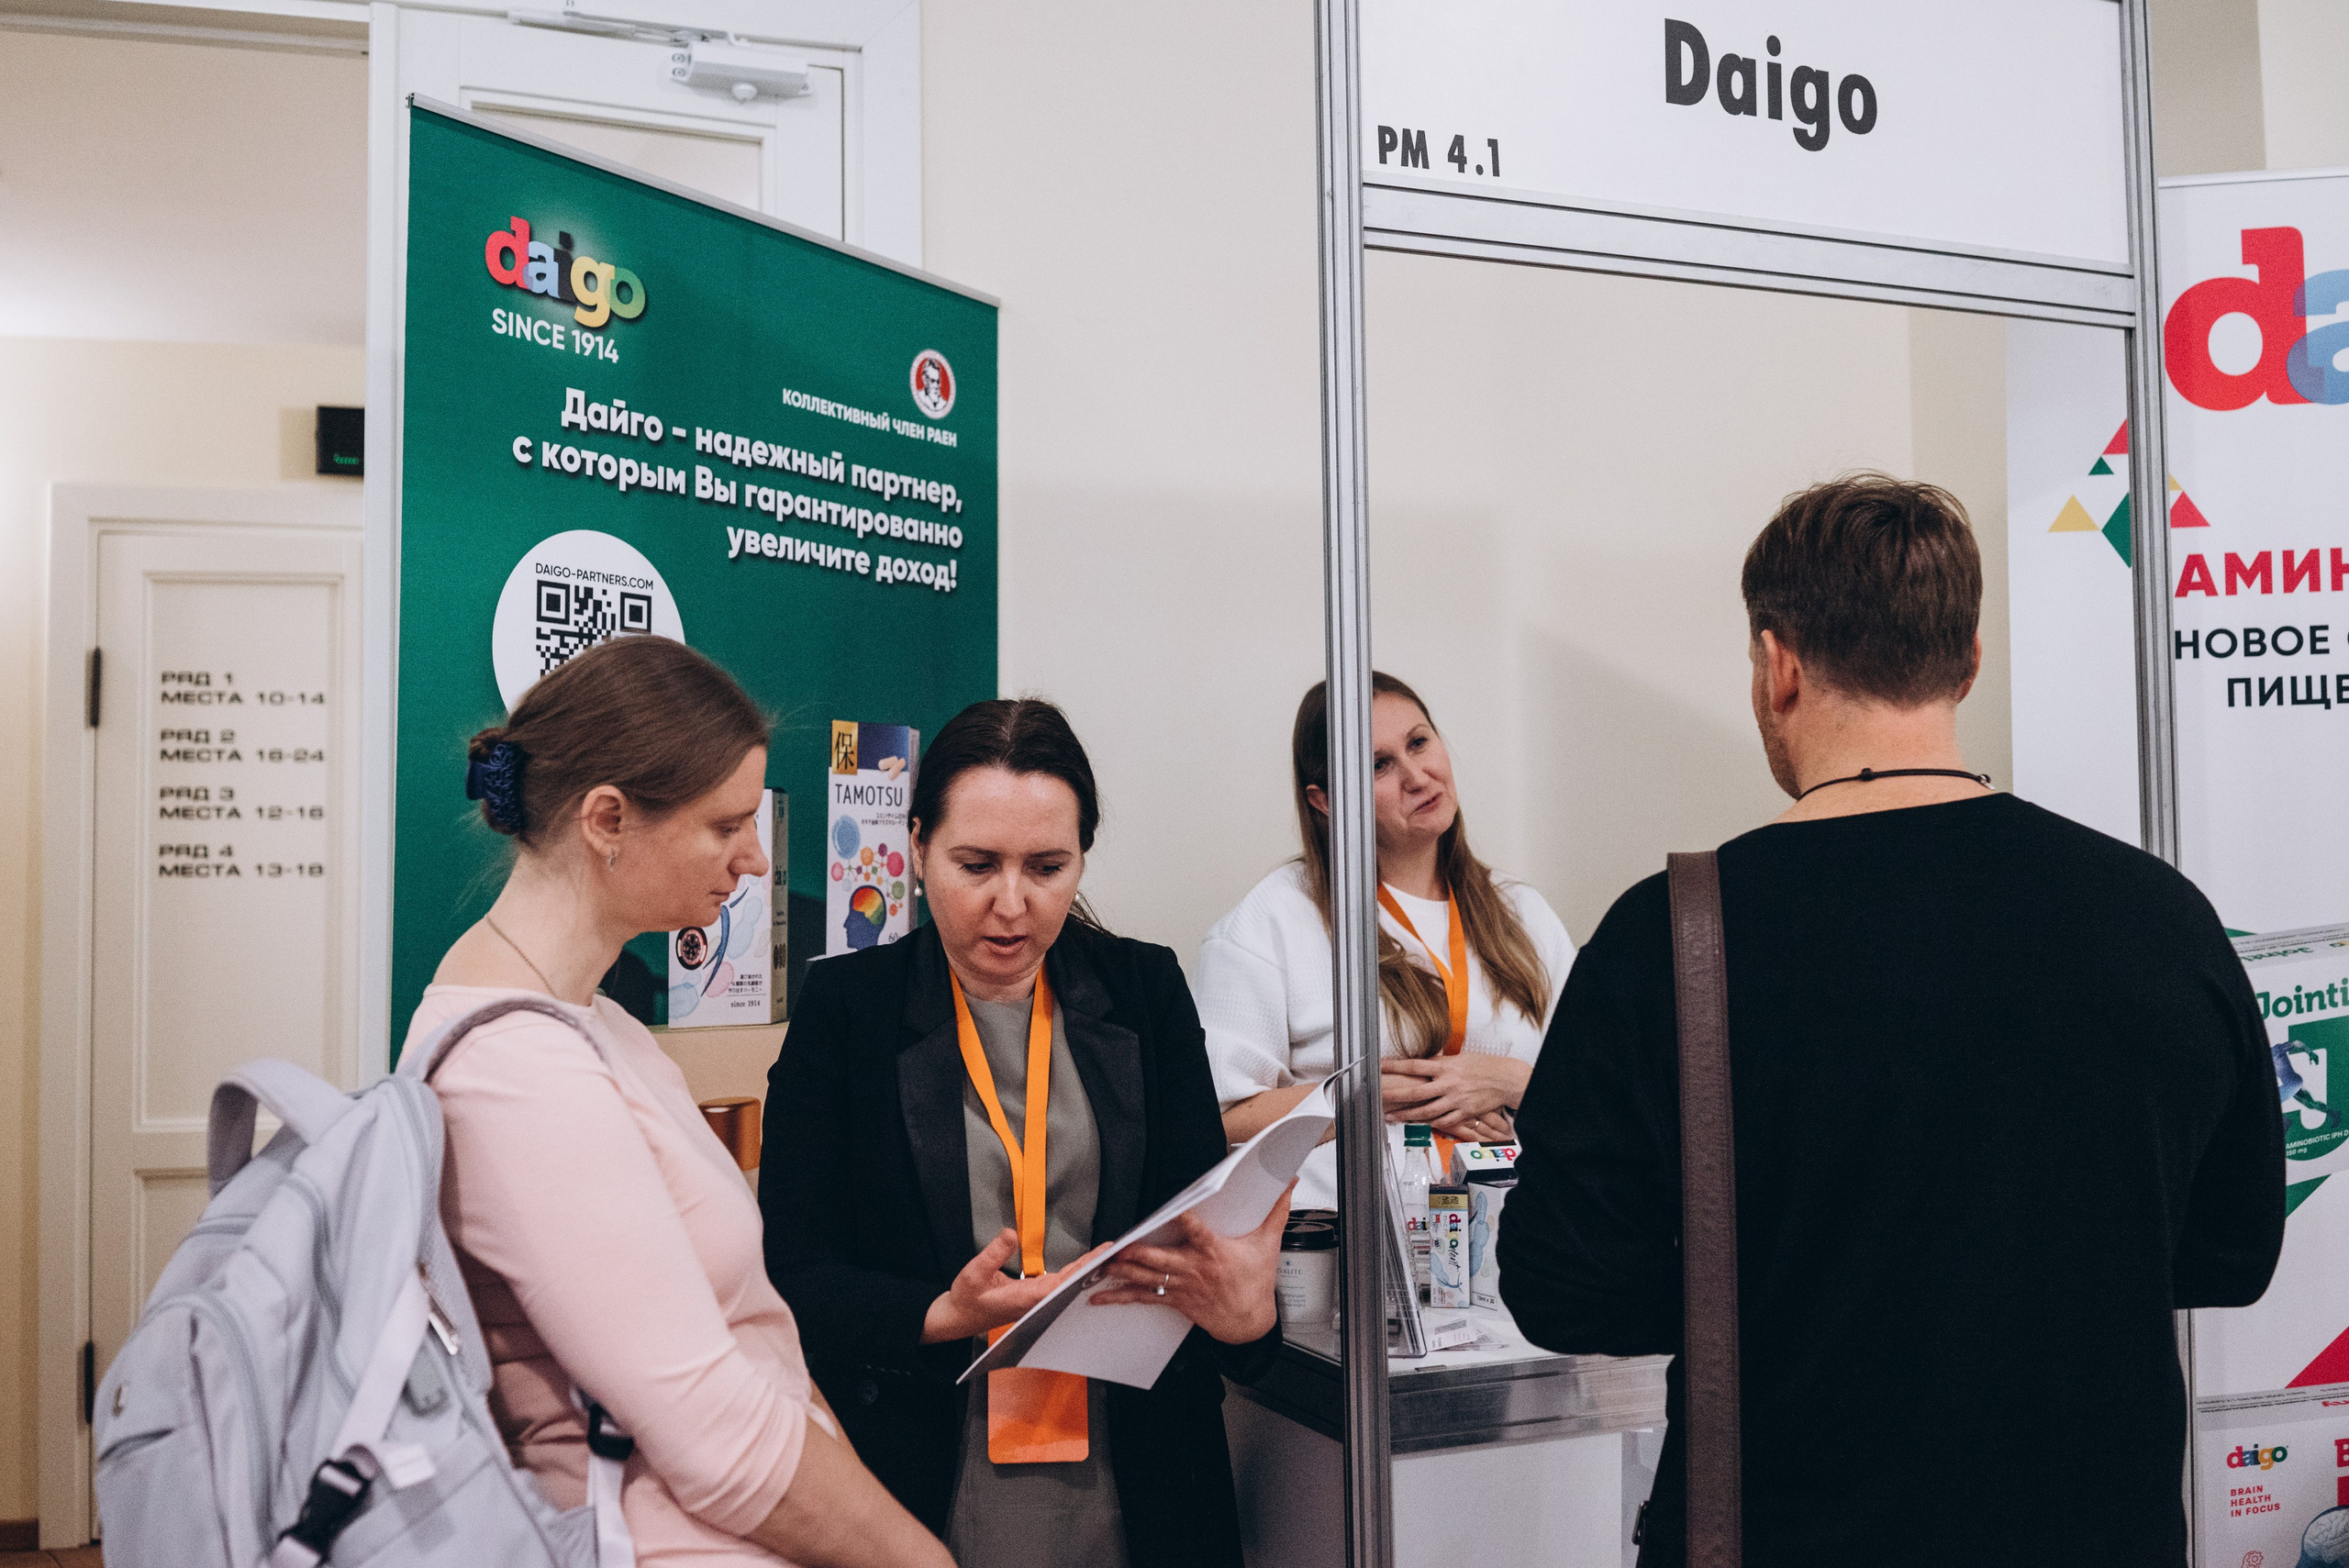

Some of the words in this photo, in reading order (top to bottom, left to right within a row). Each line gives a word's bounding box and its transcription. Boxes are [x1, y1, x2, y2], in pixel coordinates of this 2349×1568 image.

[1664, 17, 1877, 151] Daigo
[1447, 134, 1500, 177] 4.1
[485, 216, 646, 328] daigo
[492, 307, 565, 350] SINCE
[571, 329, 619, 363] 1914
[783, 388, 890, 431] КОЛЛЕКТИВНЫЙ
[892, 418, 925, 440] ЧЛЕН
[927, 427, 957, 448] РАЕН
[561, 386, 663, 441] Дайго
[696, 427, 844, 484] надежный
[851, 463, 963, 513] партнер,
[512, 436, 533, 463] с
[541, 440, 686, 495] которым
[695, 464, 737, 505] Вы
[744, 484, 963, 549] гарантированно
[727, 526, 871, 575] увеличите
[875, 555, 957, 593] доход!
[535, 562, 653, 590] DAIGO-PARTNERS.COM
[2175, 625, 2331, 660] НОВОЕ
[161, 671, 210, 686] РЯД
[225, 672, 232, 685] 1
[161, 690, 242, 706] МЕСТА
[2227, 673, 2349, 710] ПИЩЕ
[160, 728, 210, 744] РЯД
[220, 728, 235, 743] 2
[160, 748, 241, 762] МЕСТА
[834, 731, 854, 770] 保
[160, 786, 209, 802] РЯД
[218, 786, 235, 801] 3
[835, 784, 903, 806] TAMOTSU
[159, 805, 241, 820] МЕСТА
[159, 843, 209, 859] РЯД
[218, 844, 233, 858] 4
[159, 862, 241, 878] МЕСТА
[2286, 1133, 2331, 1150] AMINOBIOTIC
[2227, 1444, 2288, 1471] daigo
[2231, 1485, 2264, 1496] BRAIN
[2231, 1495, 2271, 1507] HEALTH
[2231, 1509, 2242, 1518] IN
[2245, 1503, 2280, 1515] FOCUS
